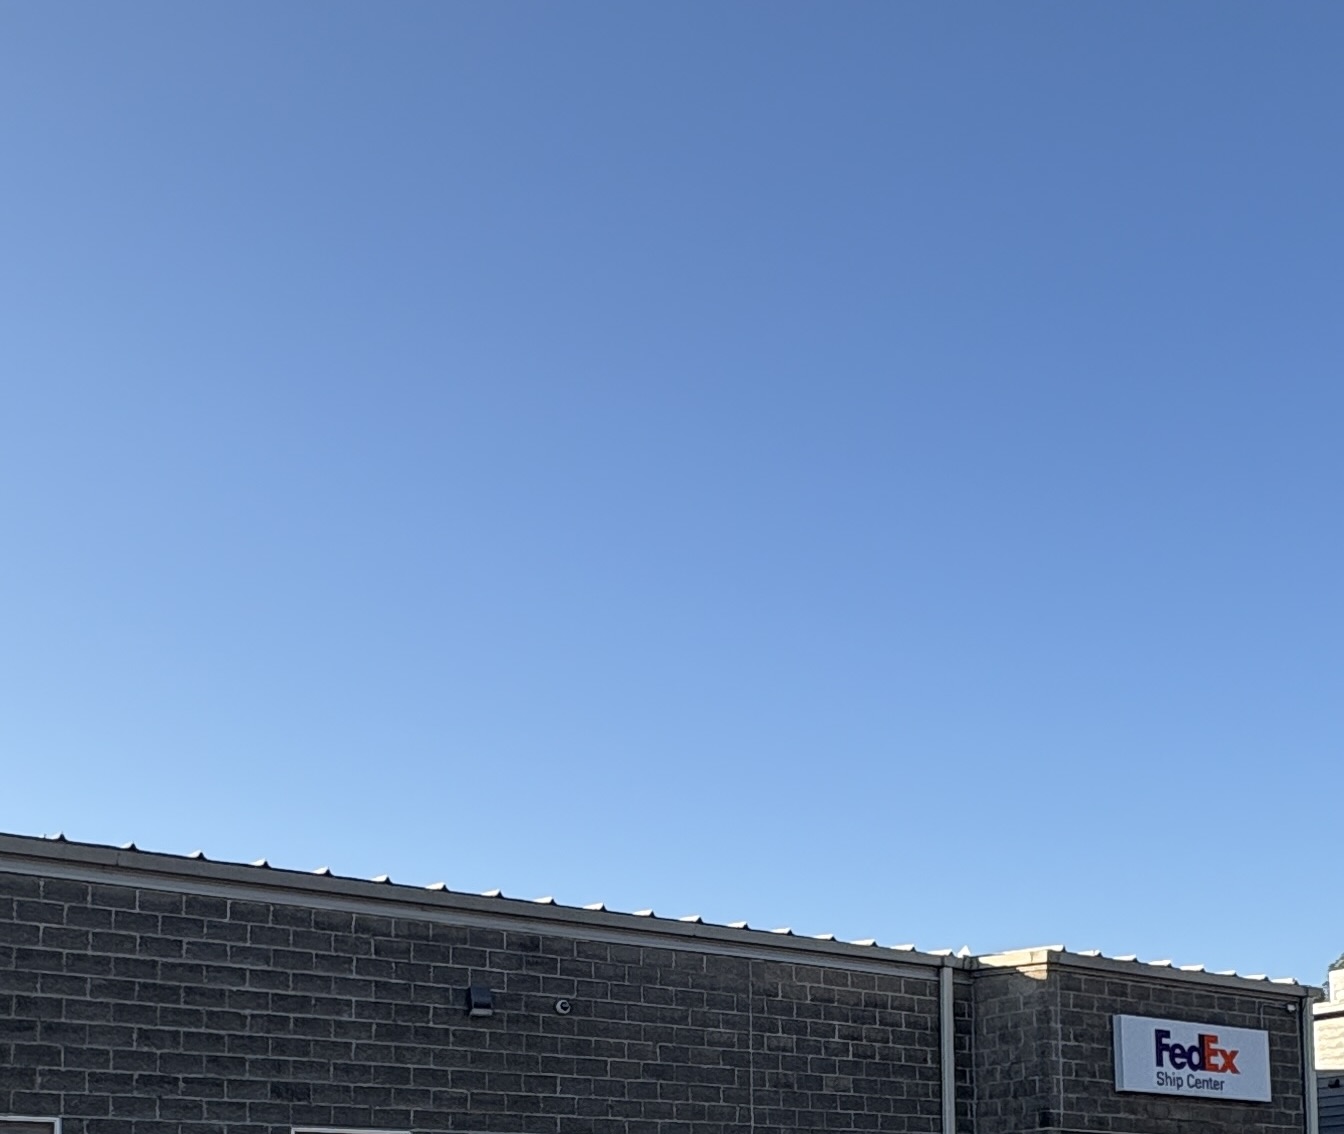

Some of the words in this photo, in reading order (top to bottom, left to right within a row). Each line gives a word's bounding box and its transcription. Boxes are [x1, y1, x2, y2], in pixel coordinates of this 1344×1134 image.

[1155, 1029, 1241, 1075] FedEx
[1156, 1071, 1184, 1091] Ship
[1186, 1073, 1225, 1092] Center
